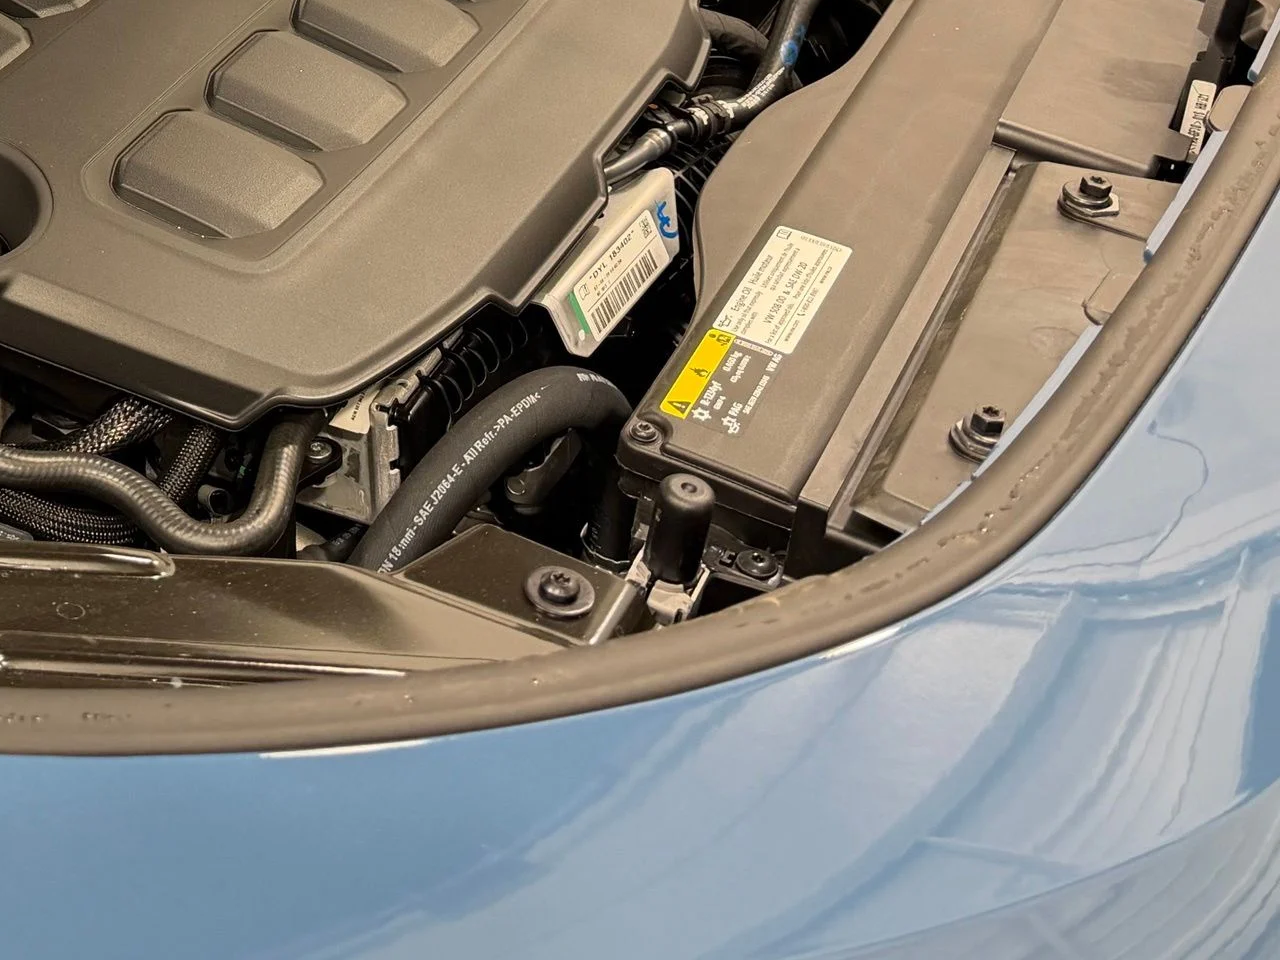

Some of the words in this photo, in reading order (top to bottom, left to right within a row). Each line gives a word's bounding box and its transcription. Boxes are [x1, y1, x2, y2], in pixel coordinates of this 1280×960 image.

[748, 271, 762, 284] Huile
[758, 254, 773, 271] moteur
[784, 277, 797, 289] SAE
[730, 294, 747, 311] Engine
[741, 286, 752, 295] Oil
[775, 295, 786, 304] 00
[769, 302, 782, 314] 508
[763, 313, 774, 323] VW
[730, 350, 742, 358] kg
[765, 360, 777, 371] VW
[771, 352, 782, 363] AG
[727, 401, 742, 416] PAG
[388, 545, 401, 560] 18
[413, 500, 433, 525] SAE
[430, 463, 462, 504] J2064-E
[463, 447, 478, 464] All
[473, 430, 497, 451] Refr.
